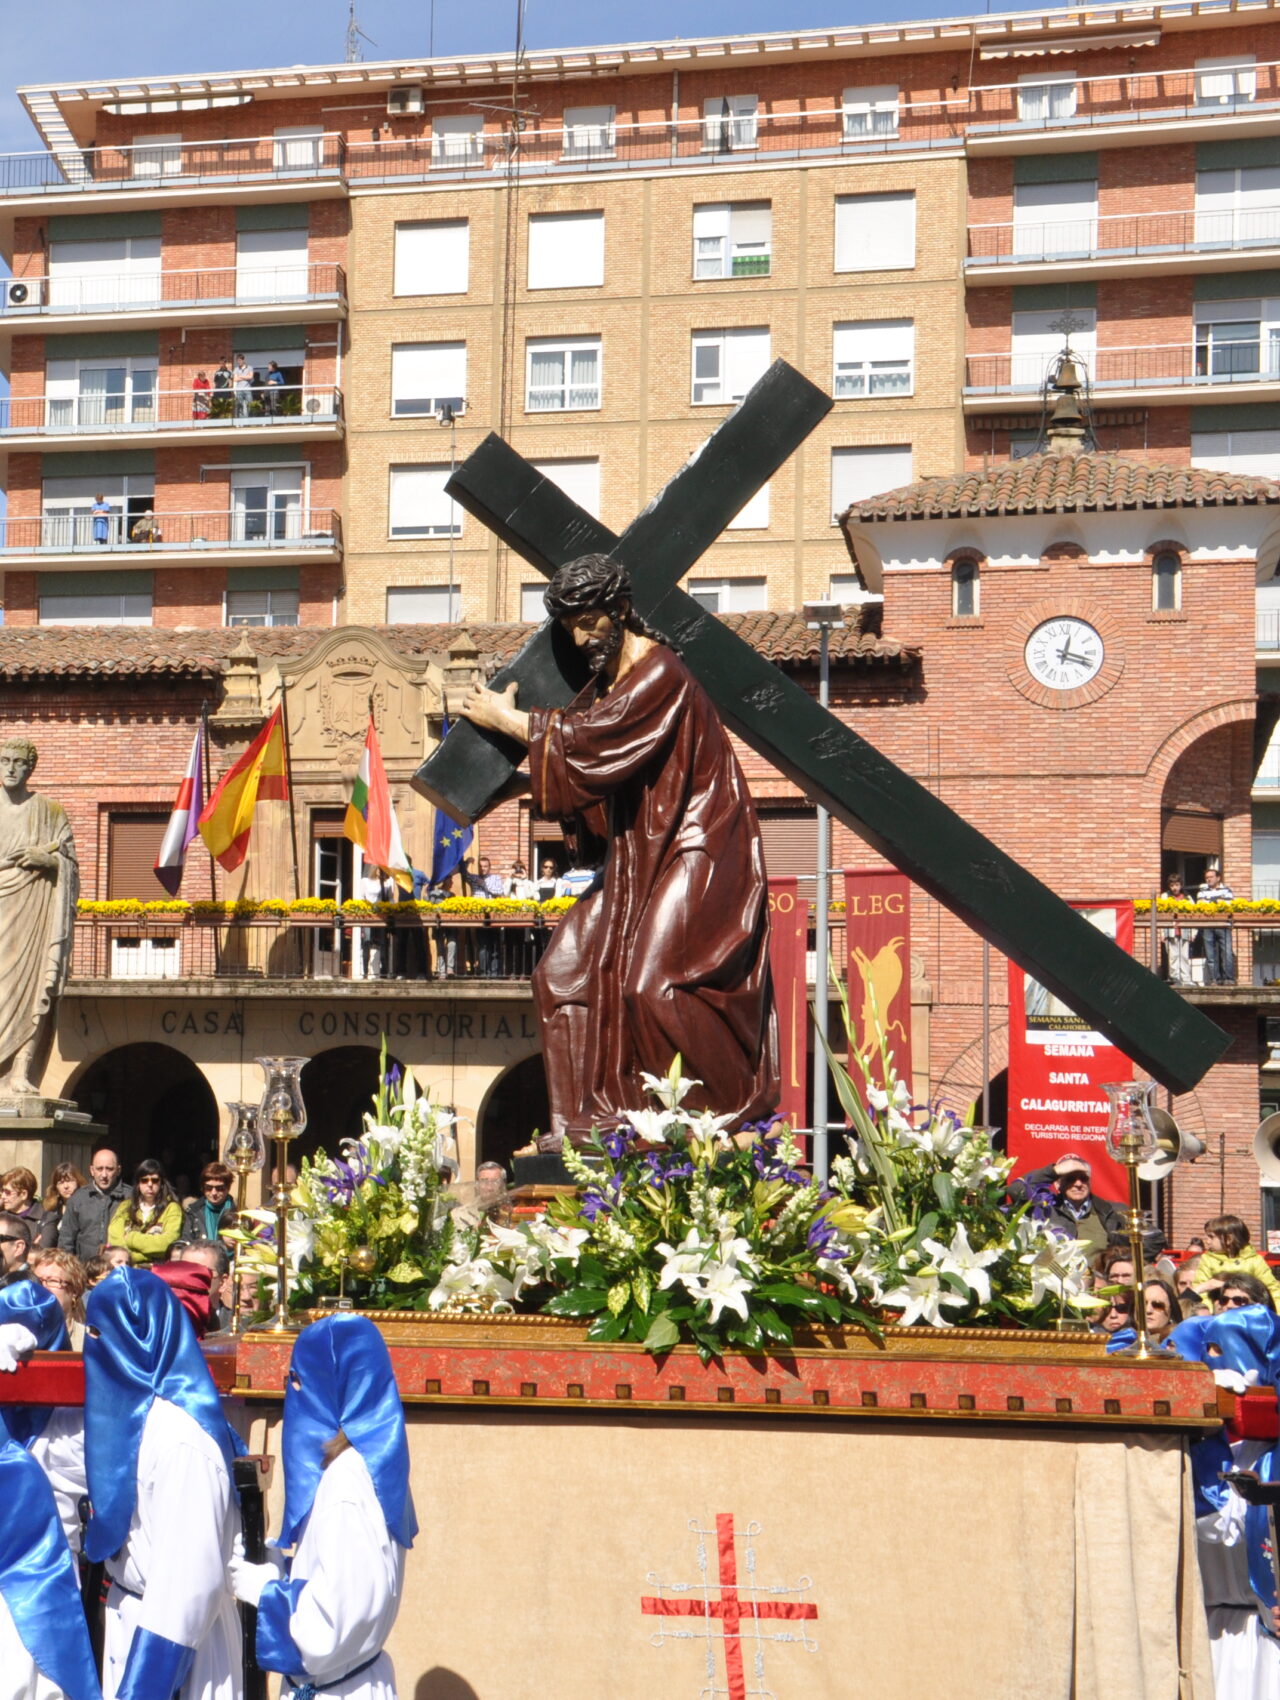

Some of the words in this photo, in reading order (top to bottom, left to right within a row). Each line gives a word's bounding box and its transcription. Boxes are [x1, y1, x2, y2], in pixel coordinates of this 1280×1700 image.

[851, 893, 905, 916] LEG
[162, 1010, 243, 1036] CASA
[299, 1011, 536, 1039] CONSISTORIAL
[1028, 1016, 1062, 1024] SEMANA
[1044, 1044, 1095, 1057] SEMANA
[1049, 1072, 1090, 1085] SANTA
[1020, 1098, 1112, 1113] CALAGURRITAN
[1024, 1123, 1069, 1132] DECLARADA
[1070, 1125, 1081, 1133] DE
[1083, 1126, 1109, 1134] INTER
[1030, 1131, 1070, 1140] TURISTICO
[1071, 1133, 1107, 1141] REGIONA
